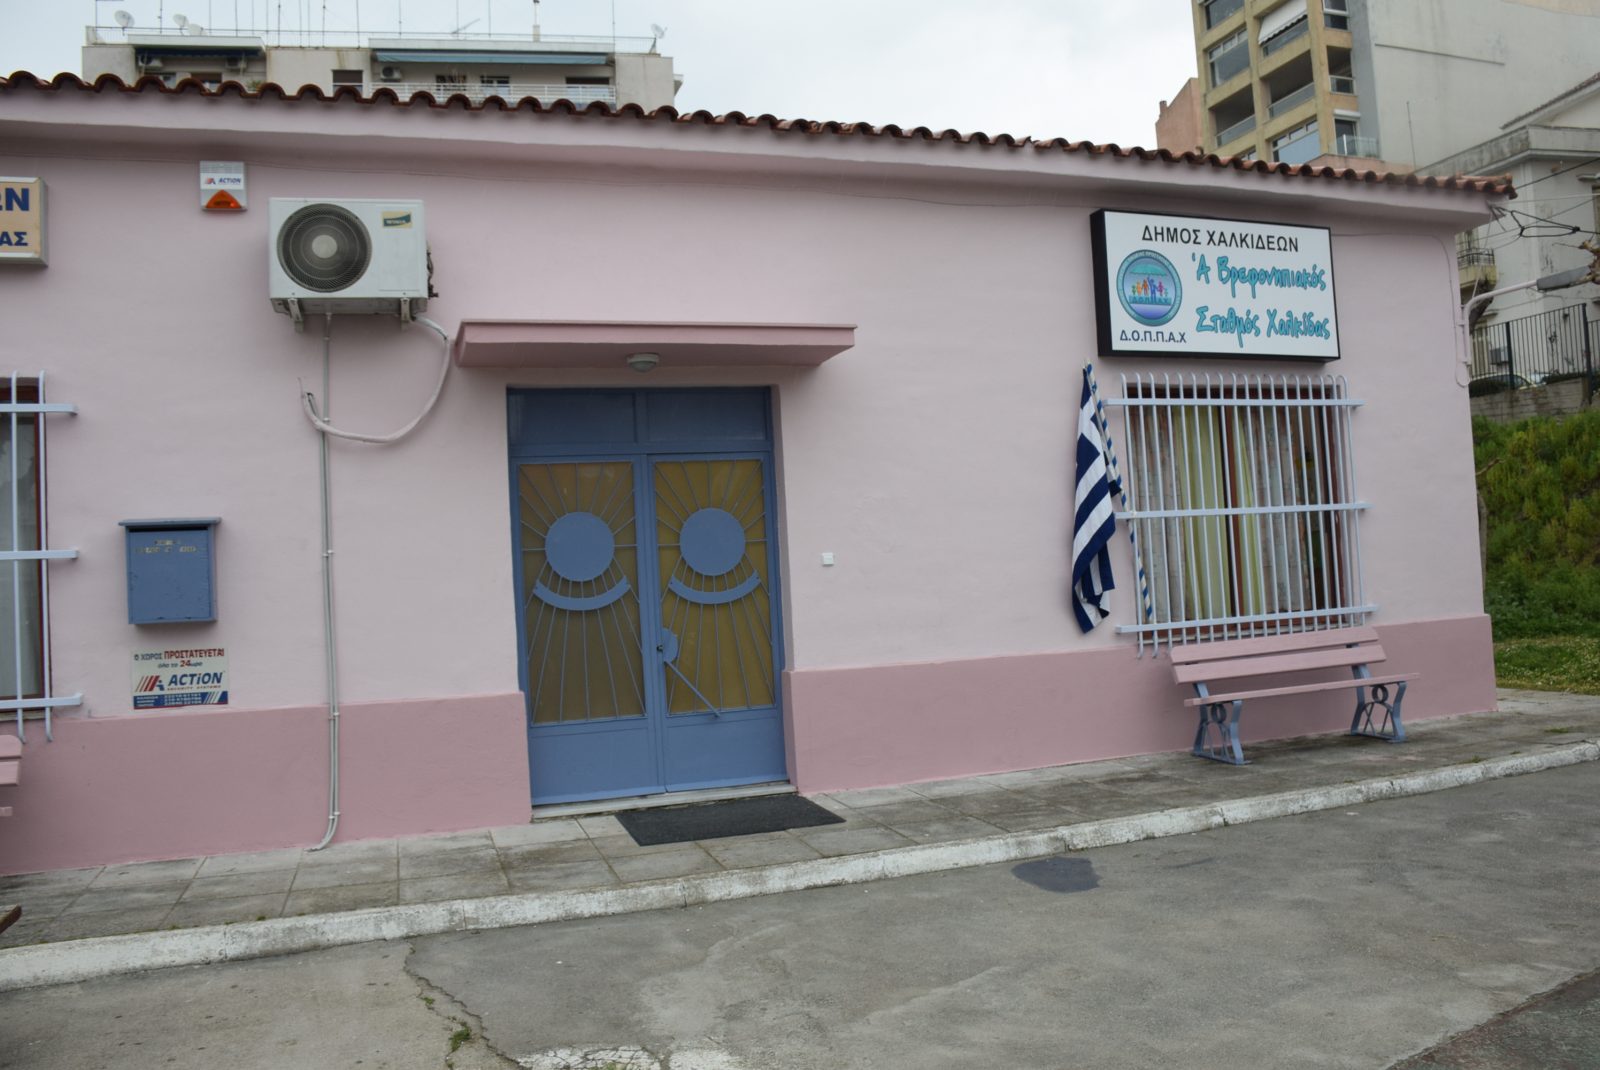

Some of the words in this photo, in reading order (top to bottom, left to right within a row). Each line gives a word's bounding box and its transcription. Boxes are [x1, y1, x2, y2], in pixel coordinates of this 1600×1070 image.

[0, 187, 30, 212] Ν
[1141, 225, 1202, 245] ΔΗΜΟΣ
[1206, 230, 1299, 252] ΧΑΛΚΙΔΕΩΝ
[1217, 256, 1327, 299] Βρεφονηπιακός
[1120, 329, 1187, 343] Δ.Ο.Π.Π.Α.Χ
[1196, 306, 1260, 348] Σταθμός
[1266, 309, 1331, 340] Χαλκίδας
[164, 648, 224, 659] ΠΡΟΣΤΑΤΕΥΕΤΑΙ
